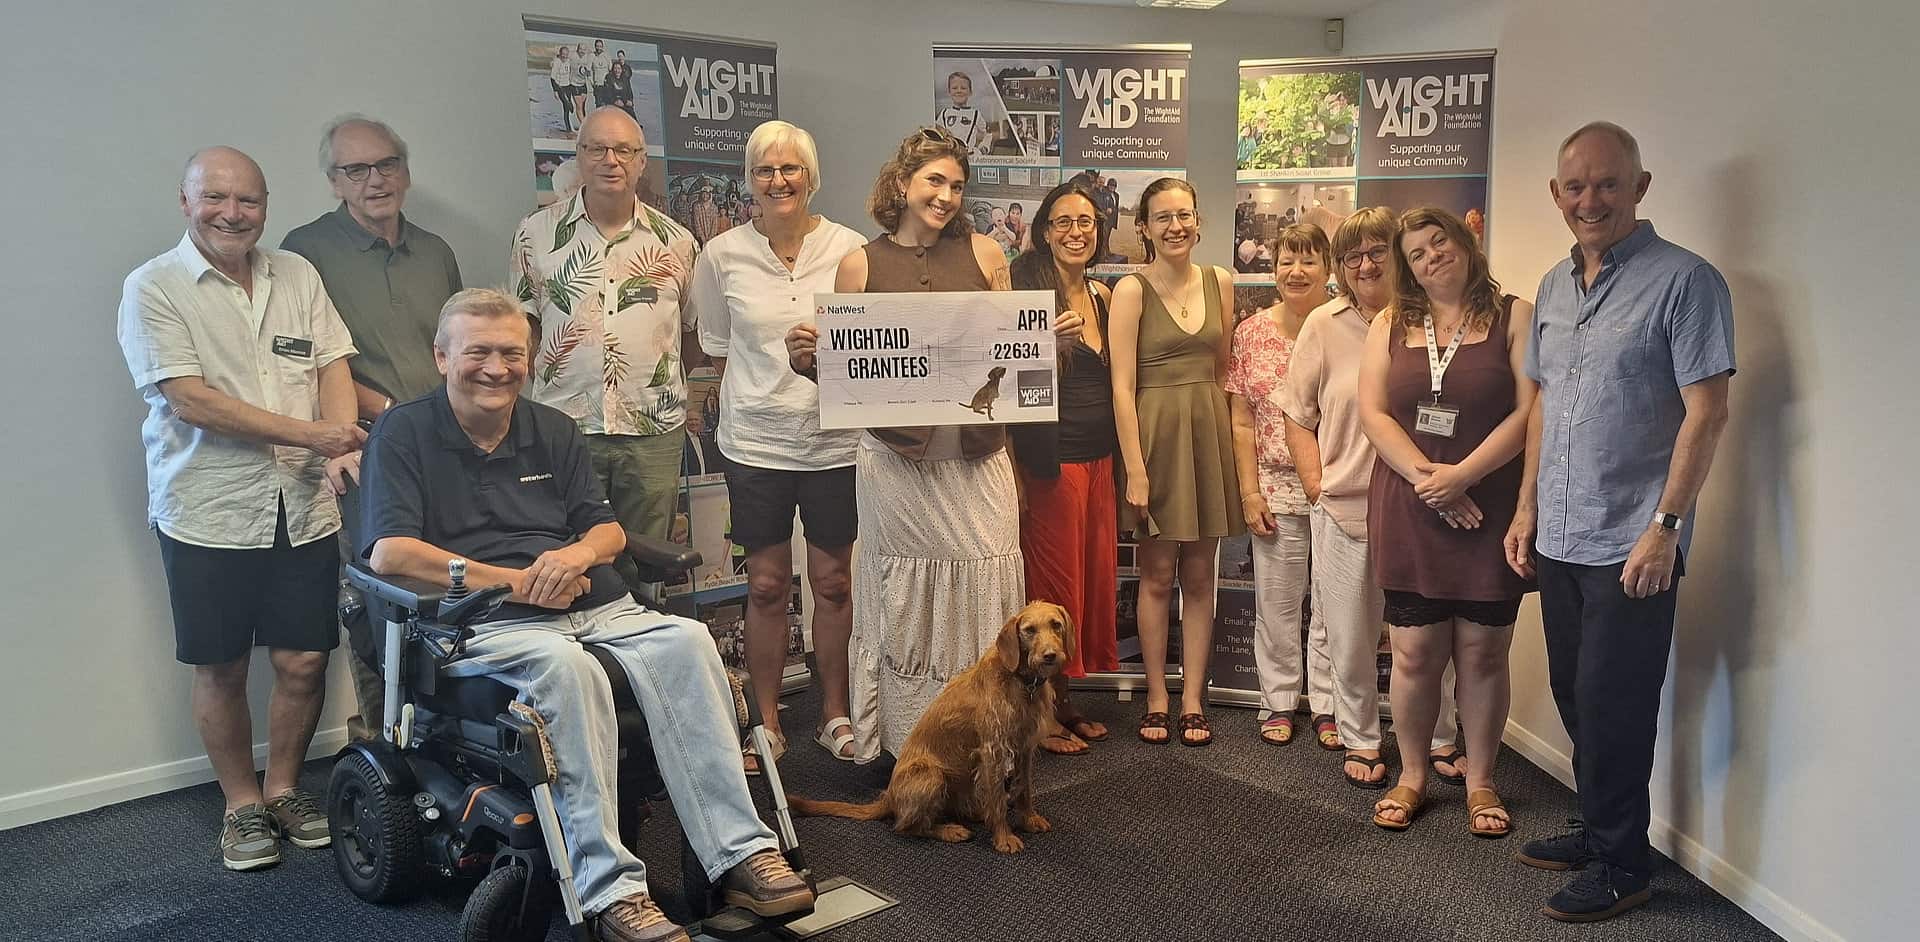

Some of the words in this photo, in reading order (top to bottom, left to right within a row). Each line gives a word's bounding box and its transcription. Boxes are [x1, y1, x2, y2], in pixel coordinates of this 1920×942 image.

[663, 55, 774, 96] WIGHT
[1065, 68, 1186, 101] WIGHT
[1366, 73, 1489, 109] WIGHT
[740, 108, 772, 118] Foundation
[1144, 107, 1154, 115] The
[1155, 107, 1180, 118] WightAid
[1444, 113, 1454, 121] The
[1455, 112, 1482, 122] WightAid
[1144, 115, 1181, 124] Foundation
[1444, 121, 1482, 130] Foundation
[694, 126, 741, 140] Supporting
[685, 140, 715, 152] unique
[717, 141, 746, 153] Comm
[1092, 135, 1143, 148] Supporting
[1146, 137, 1162, 146] our
[1082, 149, 1114, 160] unique
[1116, 149, 1169, 160] Community
[1390, 143, 1442, 155] Supporting
[1445, 143, 1461, 153] our
[1378, 158, 1411, 169] unique
[1413, 156, 1469, 168] Community
[827, 305, 866, 315] NatWest
[1017, 309, 1048, 331] APR
[830, 327, 910, 351] WIGHTAID
[847, 356, 928, 379] GRANTEES
[1020, 388, 1051, 398] WIGHT
[1240, 608, 1253, 617] Tel:
[1224, 617, 1247, 626] Email:
[1226, 635, 1240, 644] The
[1216, 644, 1230, 653] Elm
[1231, 646, 1252, 656] Lane,
[1234, 664, 1258, 673] Charit
